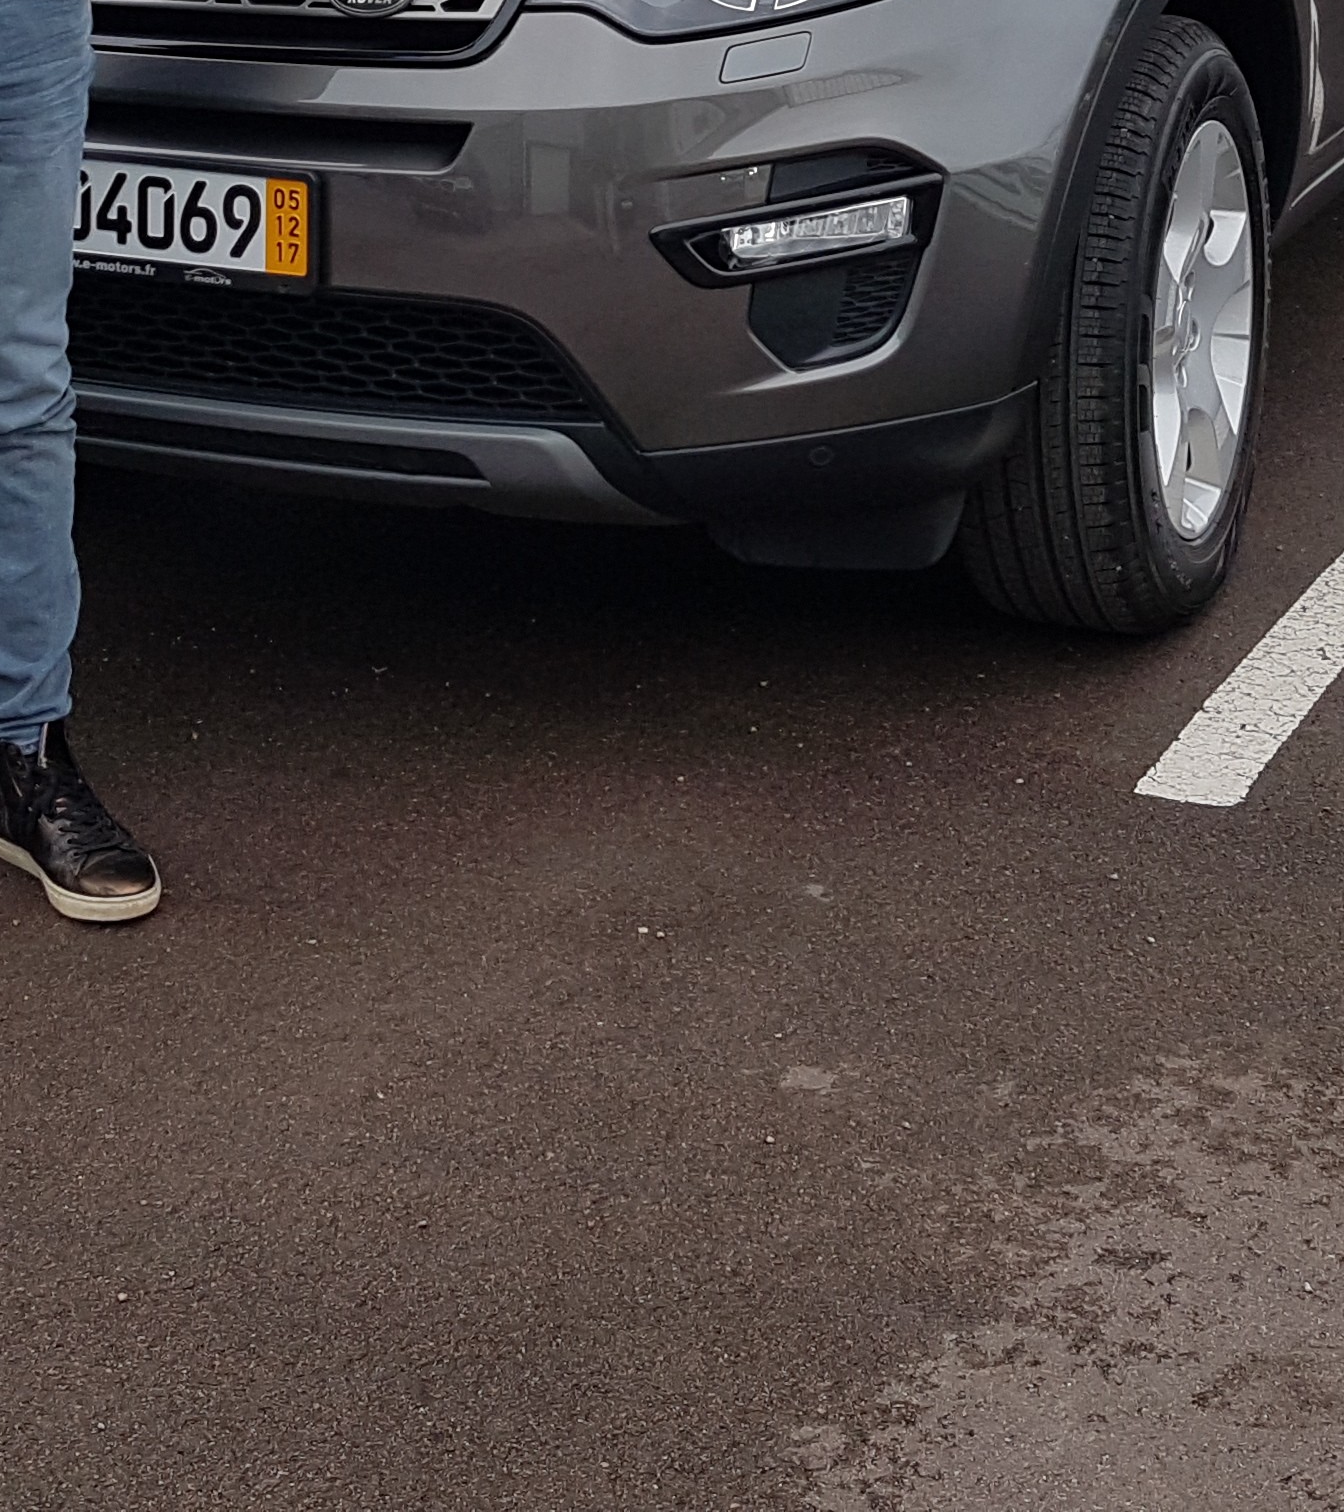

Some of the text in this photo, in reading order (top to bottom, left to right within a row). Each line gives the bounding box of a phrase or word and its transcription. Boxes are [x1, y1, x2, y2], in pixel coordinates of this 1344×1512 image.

[273, 187, 301, 211] 05
[275, 215, 301, 238] 12
[275, 241, 301, 264] 17
